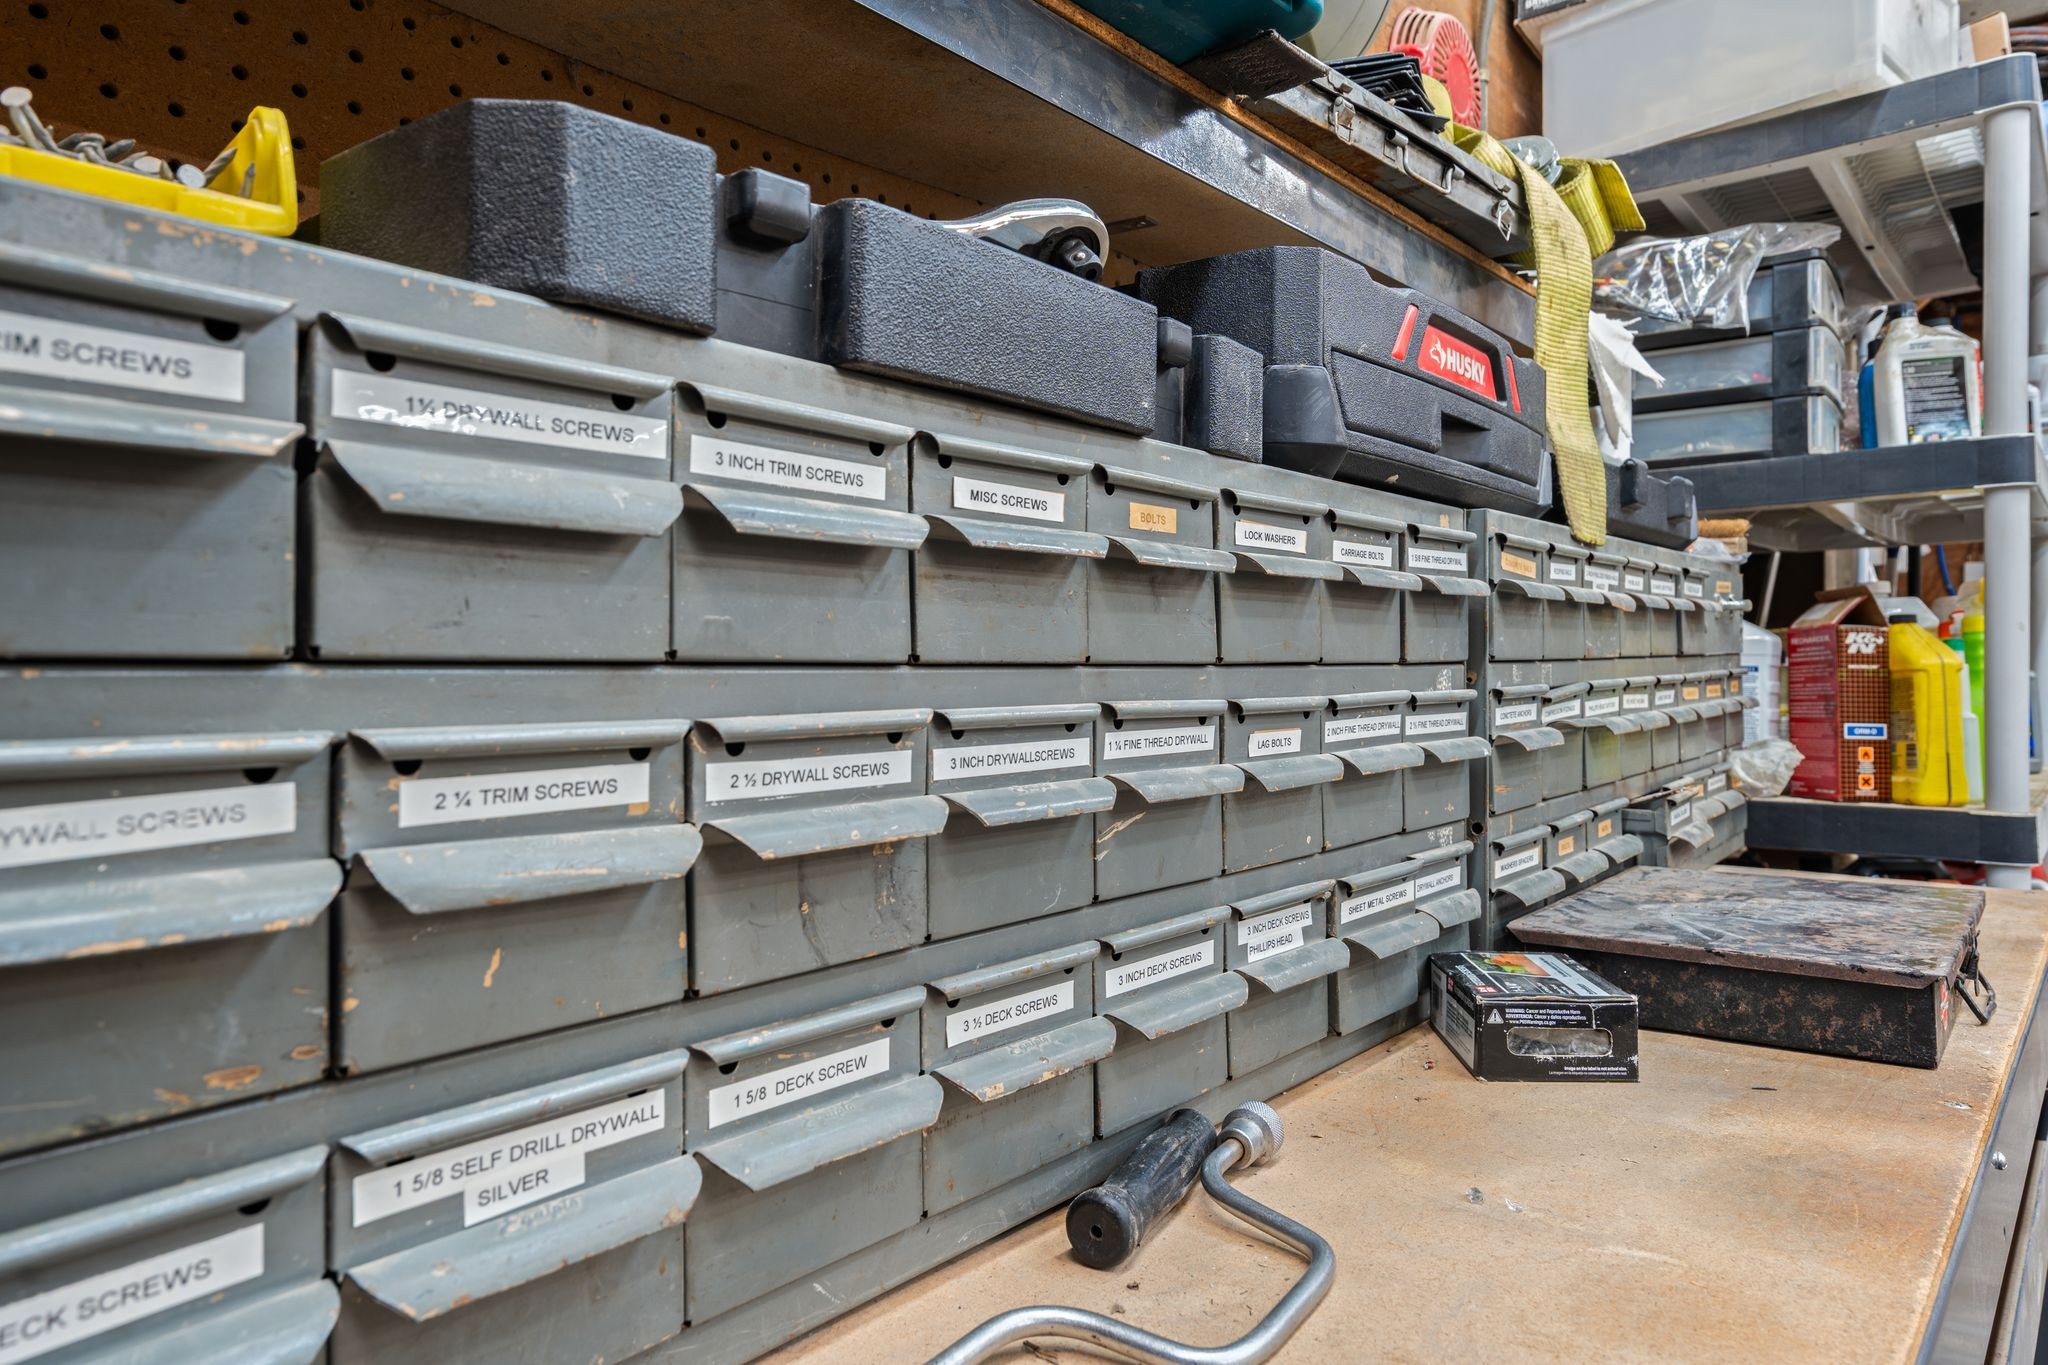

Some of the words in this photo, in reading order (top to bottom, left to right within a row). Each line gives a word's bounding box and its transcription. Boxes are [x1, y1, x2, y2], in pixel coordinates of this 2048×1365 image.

[0, 331, 40, 356] IM
[50, 338, 193, 380] SCREWS
[1447, 348, 1486, 386] HUSKY
[443, 401, 545, 432] DRYWALL
[551, 417, 635, 443] SCREWS
[715, 451, 724, 466] 3
[728, 453, 765, 473] INCH
[769, 459, 802, 478] TRIM
[805, 466, 864, 488] SCREWS
[970, 488, 998, 505] MISC
[1000, 494, 1048, 512] SCREWS
[1140, 512, 1167, 525] BOLTS
[1244, 530, 1263, 541] LOCK
[1264, 533, 1297, 546] WASHERS
[1340, 547, 1368, 560] CARRIAGE
[1368, 551, 1385, 561] BOLTS
[1327, 728, 1331, 737] 2
[1331, 726, 1344, 737] INCH
[1344, 725, 1356, 735] FINE
[1357, 722, 1377, 733] THREAD
[1377, 720, 1401, 732] DRYWALL
[1417, 720, 1428, 728] FINE
[1428, 719, 1444, 728] THREAD
[1108, 741, 1113, 751] 1
[1123, 738, 1142, 750] FINE
[1144, 737, 1174, 748] THREAD
[1175, 733, 1209, 747] DRYWALL
[1257, 739, 1270, 750] LAG
[1271, 737, 1292, 748] BOLTS
[730, 774, 740, 789] 2
[761, 768, 829, 787] DRYWALL
[832, 762, 890, 780] SCREWS
[950, 757, 958, 770] 3
[959, 755, 985, 769] INCH
[434, 793, 447, 811] 2
[478, 786, 529, 806] TRIM
[534, 778, 619, 801] SCREWS
[116, 803, 247, 836] SCREWS
[1348, 903, 1366, 916] SHEET
[1367, 896, 1385, 911] METAL
[1385, 889, 1408, 904] SCREWS
[1247, 926, 1251, 936] 3
[1252, 922, 1267, 935] INCH
[1267, 918, 1284, 931] DECK
[1284, 910, 1310, 926] SCREWS
[1249, 939, 1275, 955] PHILLIPS
[1276, 933, 1293, 948] HEAD
[1118, 975, 1124, 987] 3
[1125, 970, 1145, 984] INCH
[1146, 962, 1168, 979] DECK
[1169, 951, 1203, 970] SCREWS
[963, 1020, 970, 1032] 3
[985, 1007, 1013, 1026] DECK
[1015, 994, 1059, 1017] SCREWS
[734, 1094, 741, 1108] 1
[746, 1086, 767, 1105] 5/8
[775, 1071, 815, 1096] DECK
[818, 1054, 868, 1082] SCREW
[394, 1180, 402, 1199] 1
[411, 1167, 444, 1193] 5/8
[450, 1149, 503, 1181] SELF
[510, 1133, 566, 1163] DRILL
[571, 1103, 661, 1145] DRYWALL
[477, 1168, 550, 1208] SILVER
[77, 1257, 213, 1322] SCREWS
